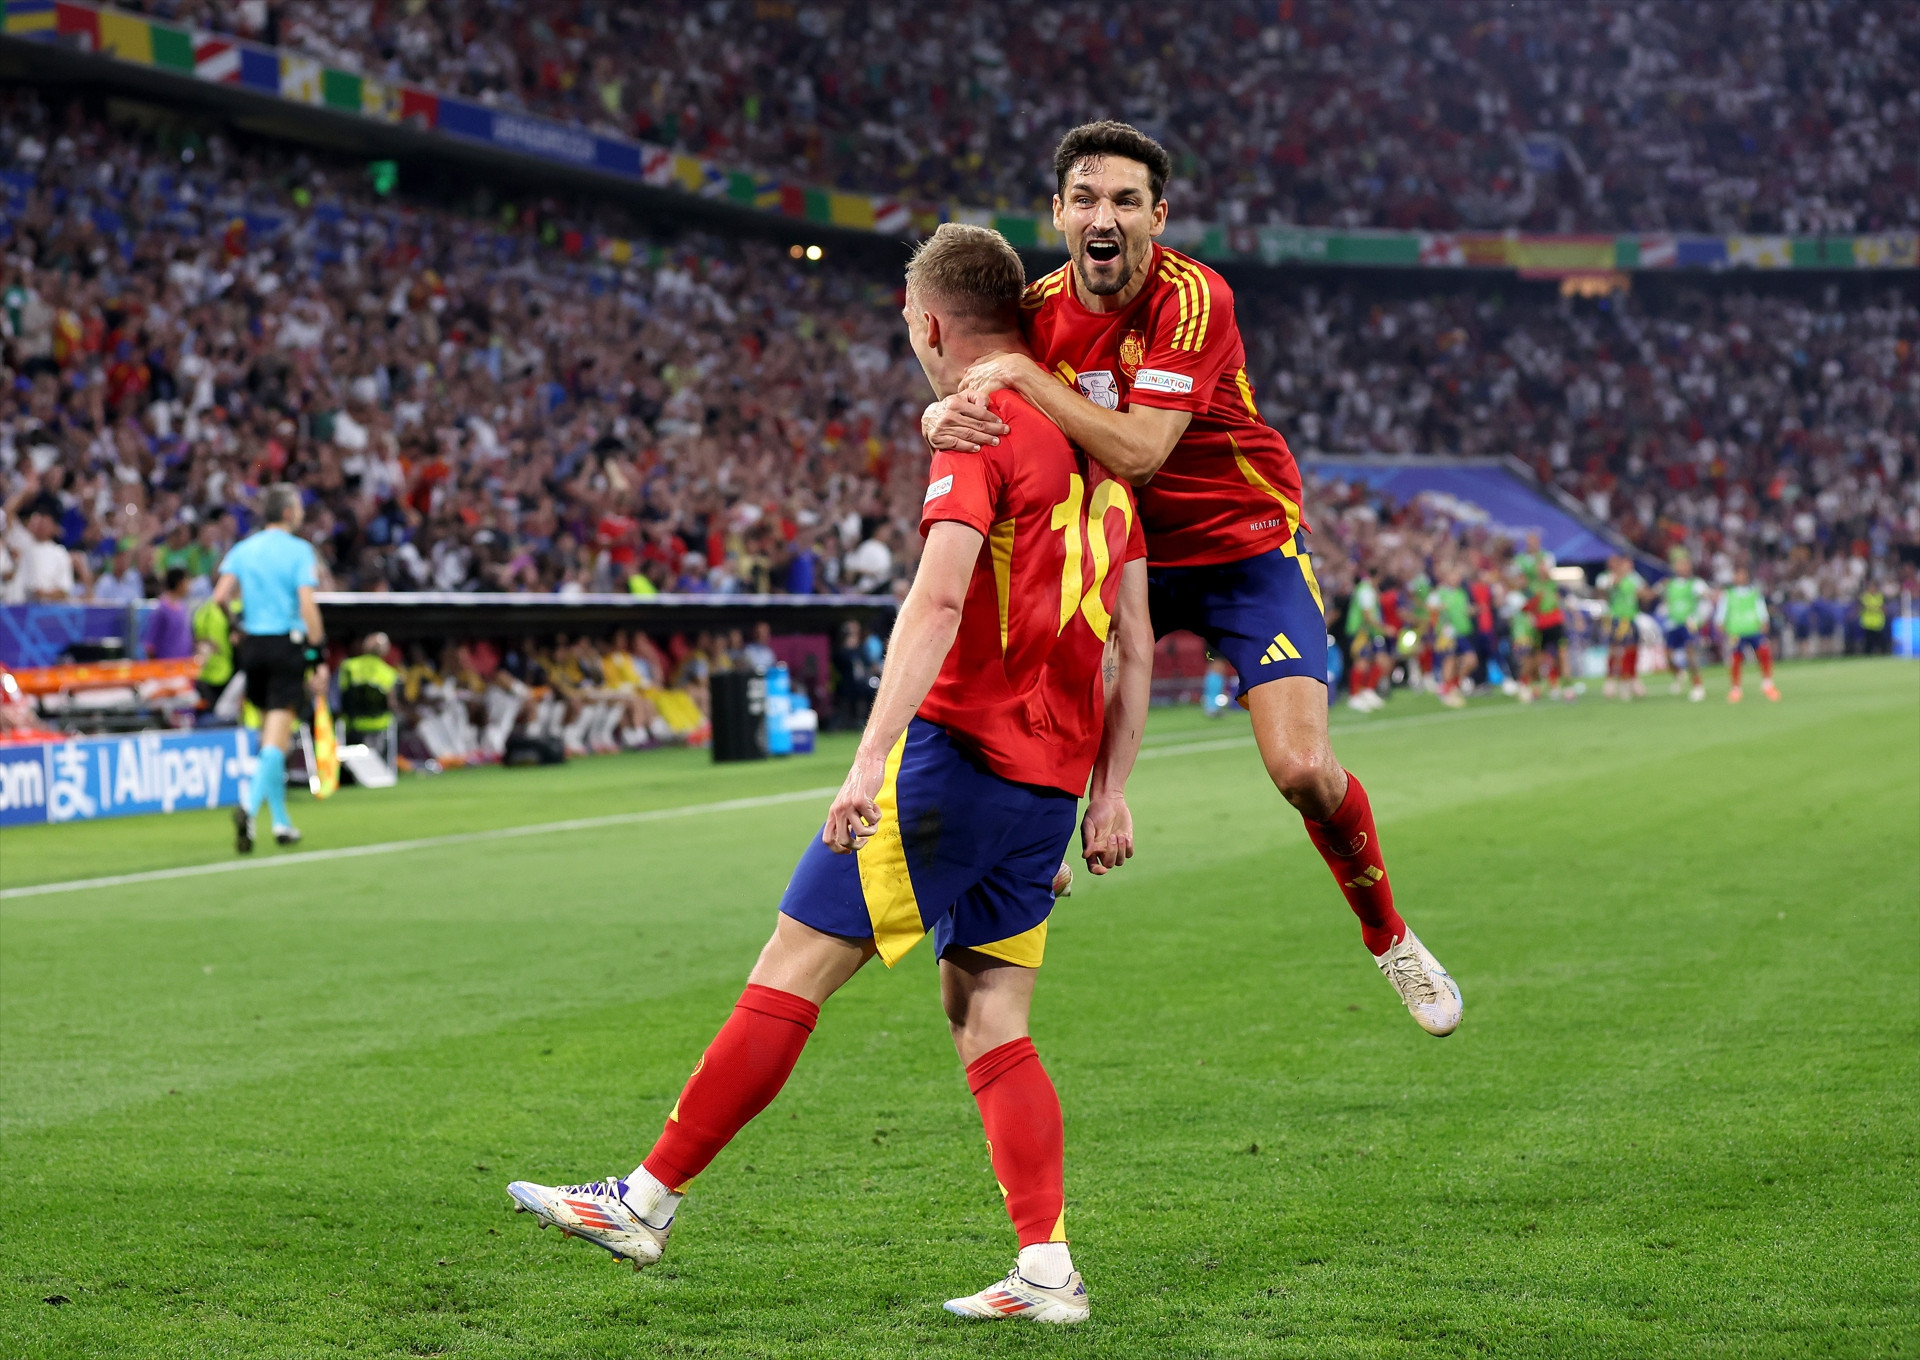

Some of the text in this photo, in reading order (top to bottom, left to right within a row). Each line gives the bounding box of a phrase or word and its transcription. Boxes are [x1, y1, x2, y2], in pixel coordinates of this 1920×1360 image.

[1136, 375, 1191, 390] FOUNDATION
[1250, 519, 1280, 531] HEAT.RDY
[1051, 473, 1133, 643] 10
